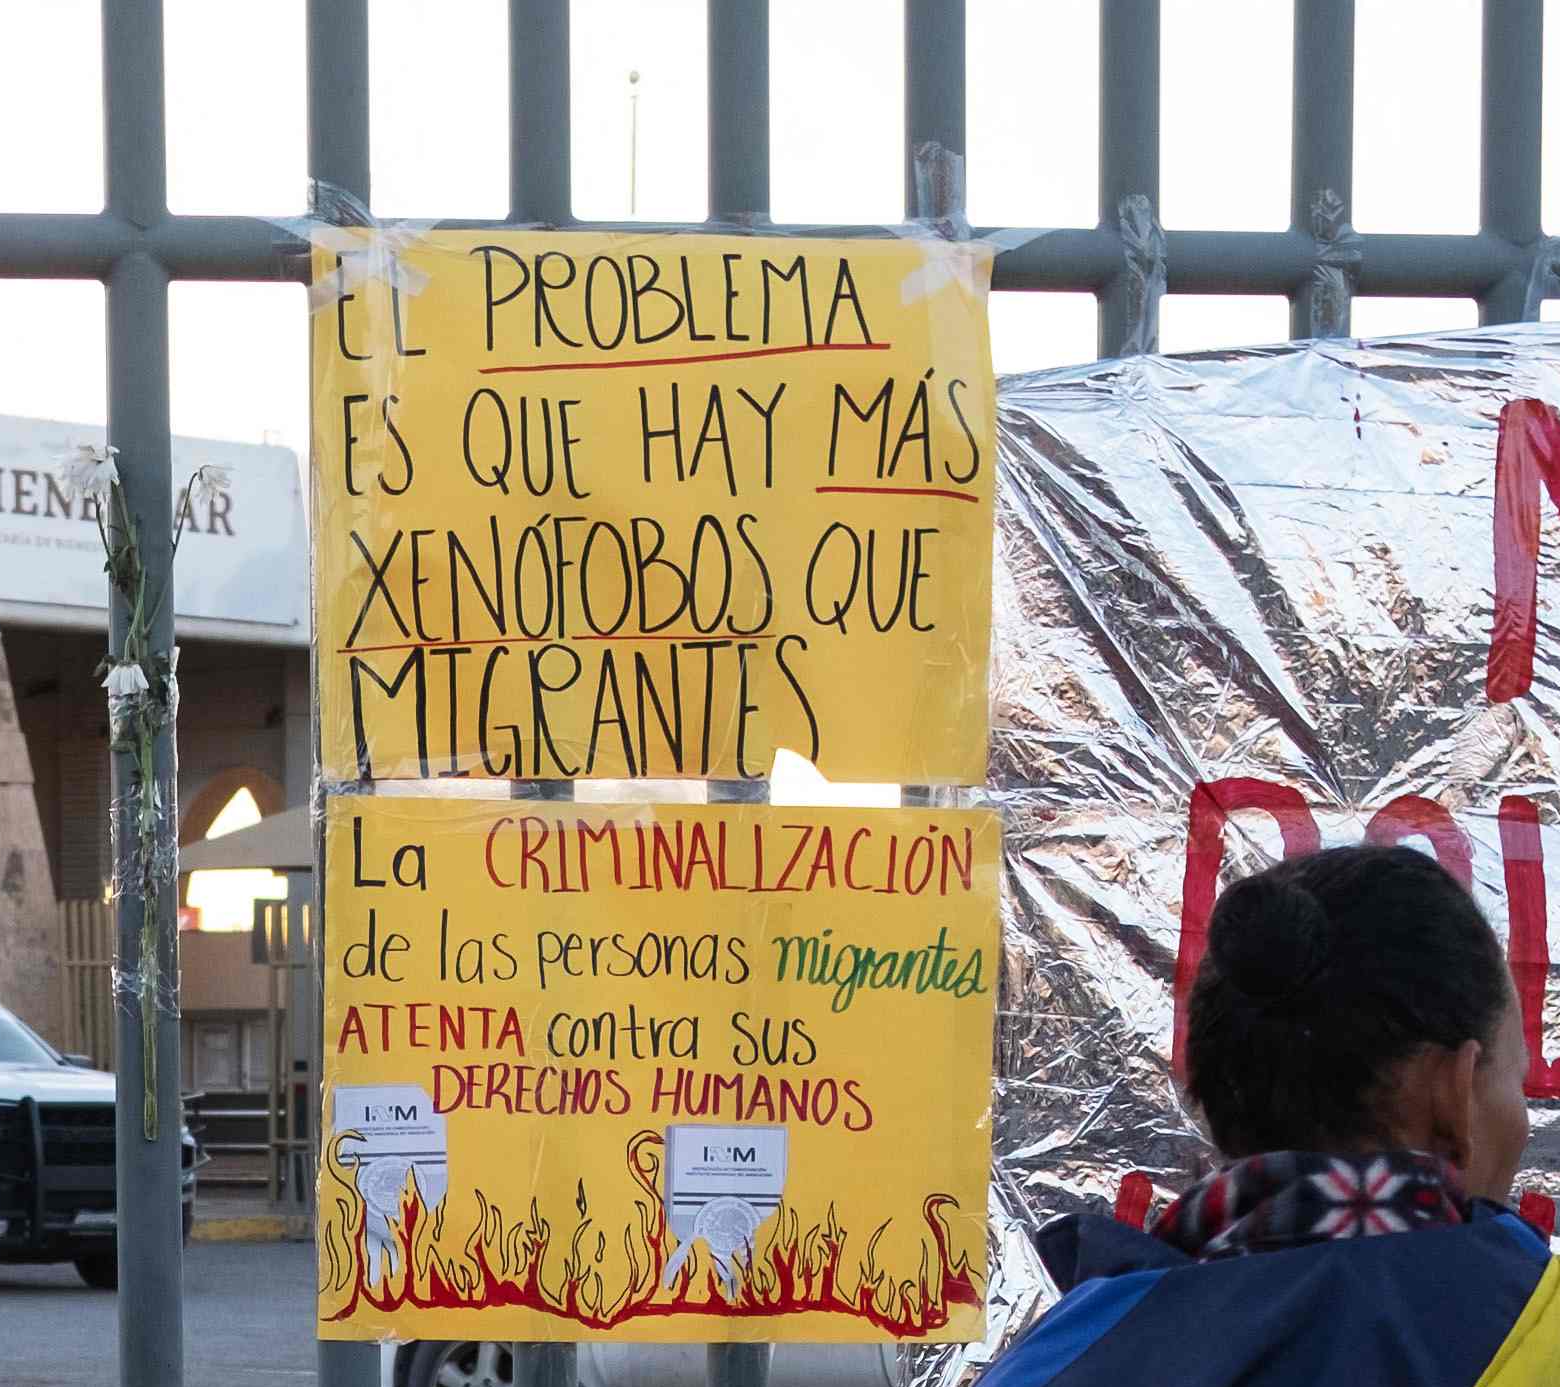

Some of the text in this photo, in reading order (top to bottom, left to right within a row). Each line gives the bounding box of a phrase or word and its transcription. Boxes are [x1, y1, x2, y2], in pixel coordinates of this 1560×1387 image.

[337, 245, 872, 360] EL PROBLEMA
[344, 367, 979, 498] ES QUE HAY MÁS
[344, 513, 940, 647] XENÓFOBOS QUE
[348, 635, 819, 780] MIGRANTES
[351, 816, 973, 896] La CRIMINALIZACIÓN
[342, 908, 989, 1014] de las personas migrantes
[337, 1002, 524, 1057] ATENTA
[547, 1004, 699, 1061] contra
[432, 1062, 874, 1133] DERECHOS HUMANOS
